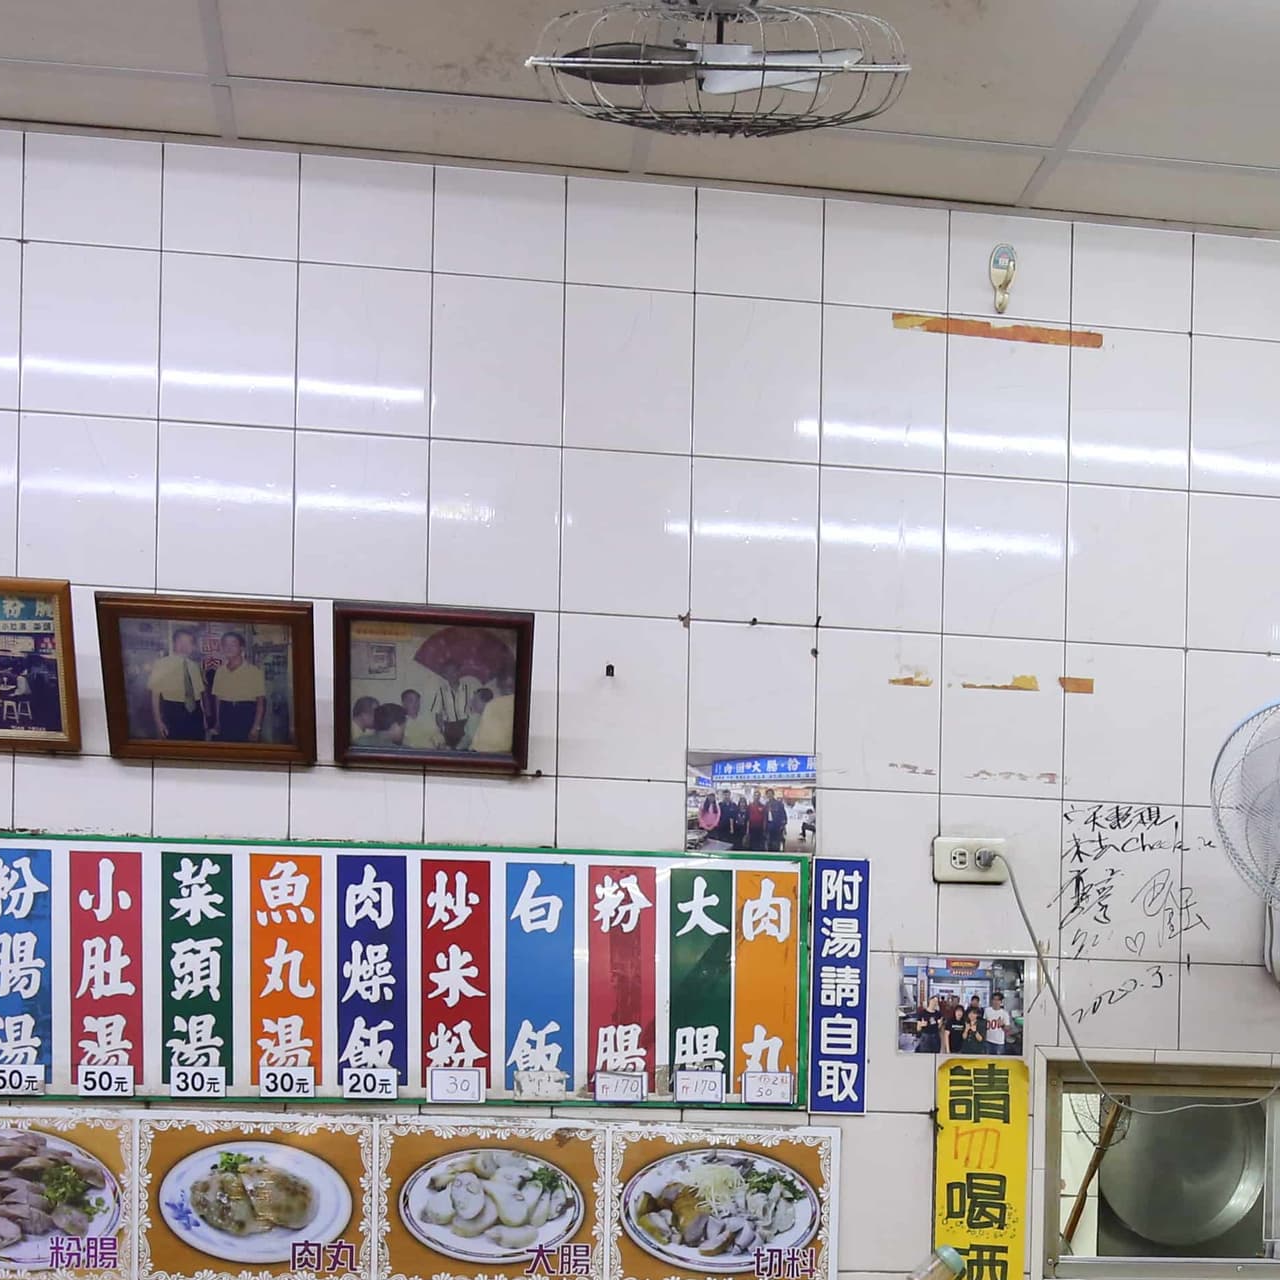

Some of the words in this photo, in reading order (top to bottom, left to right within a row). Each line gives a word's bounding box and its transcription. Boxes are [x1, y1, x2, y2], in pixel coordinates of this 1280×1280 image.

[76, 857, 136, 1066] 小肚湯
[167, 857, 226, 1067] 菜頭湯
[255, 860, 316, 1067] 魚丸湯
[339, 863, 397, 1069] 肉燥飯
[427, 870, 488, 1069] 炒米粉
[506, 869, 570, 1075] 白飯
[592, 873, 653, 1073] 粉腸
[740, 879, 793, 1076] 肉丸
[818, 868, 863, 1104] 附湯請自取
[82, 1070, 129, 1093] 50元
[175, 1071, 221, 1094] 30元
[264, 1071, 310, 1094] 30元
[348, 1072, 392, 1096] 20元
[49, 1236, 119, 1270] 粉腸
[290, 1240, 358, 1273] 肉丸
[525, 1243, 591, 1275] 大腸
[753, 1247, 817, 1280] 切料
